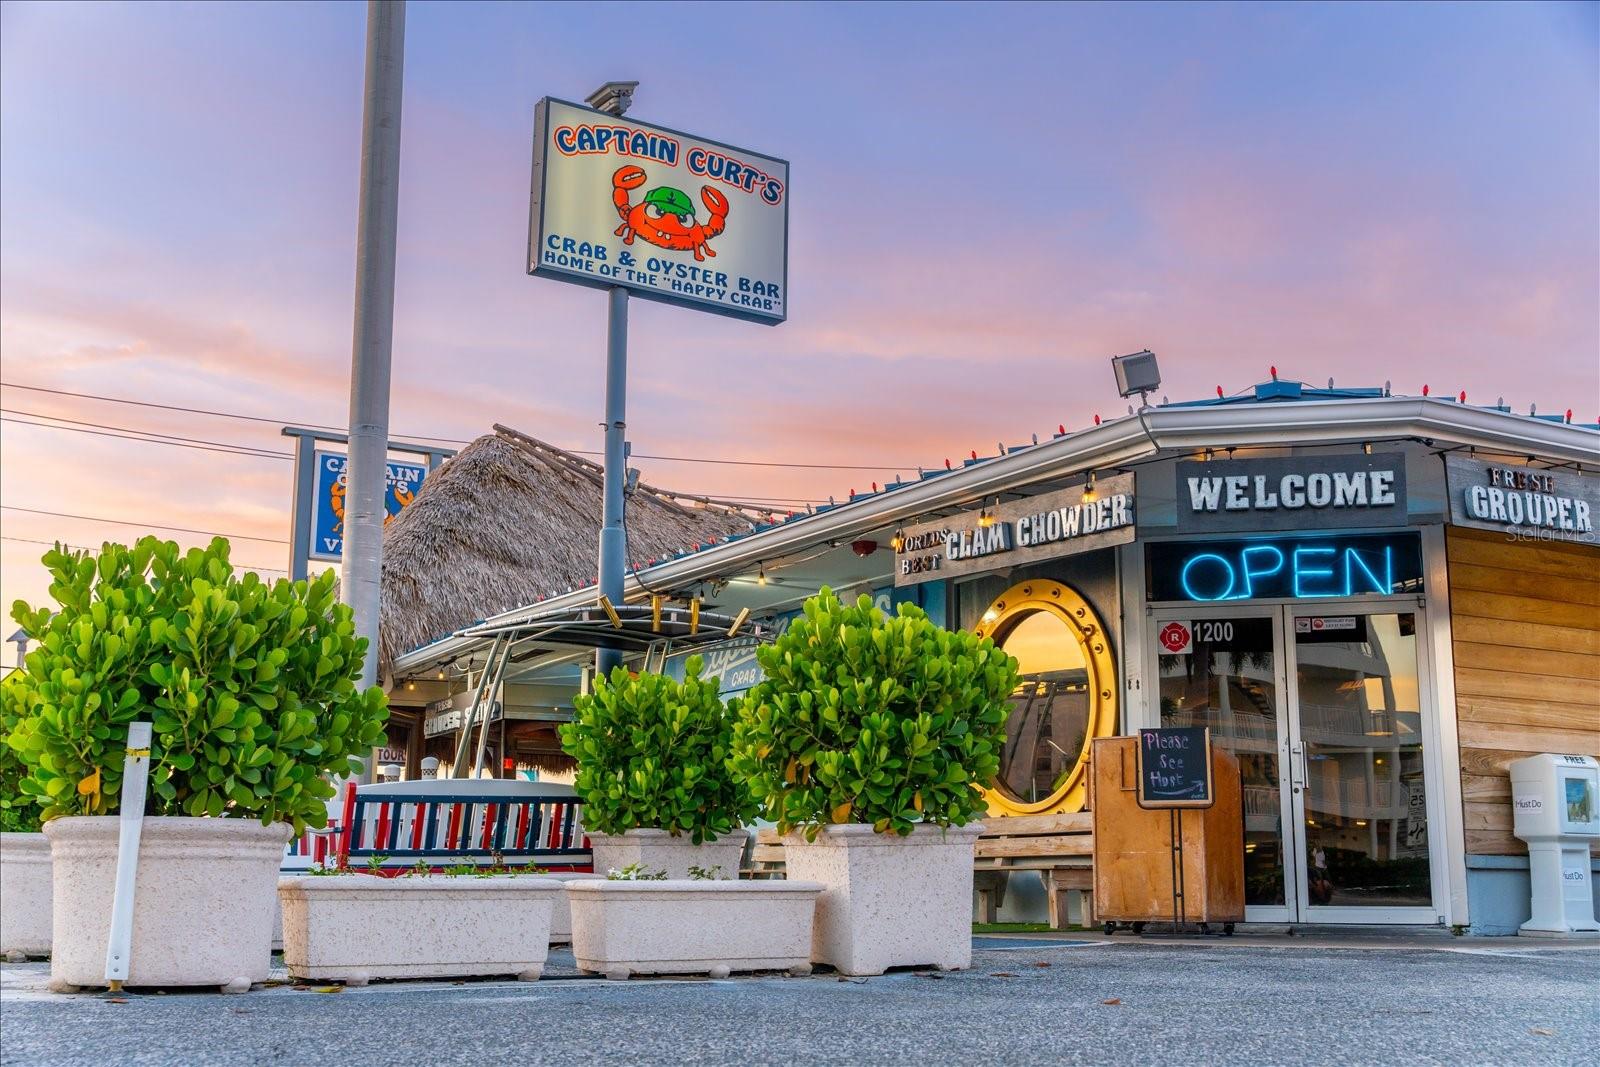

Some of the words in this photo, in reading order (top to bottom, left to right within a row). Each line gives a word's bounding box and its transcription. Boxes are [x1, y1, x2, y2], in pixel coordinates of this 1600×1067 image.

[556, 125, 678, 165] CAPTAIN
[688, 149, 783, 204] CURT'S
[547, 234, 607, 261] CRAB
[618, 251, 636, 267] &
[646, 257, 728, 288] OYSTER
[738, 276, 780, 299] BAR
[544, 250, 594, 272] HOME
[599, 263, 621, 278] OF
[626, 269, 658, 286] THE
[663, 277, 726, 300] "HAPPY
[731, 292, 781, 311] CRAB"
[1187, 470, 1396, 512] WELCOME
[1489, 467, 1555, 493] FRESH
[1468, 485, 1592, 532] GROUPER
[946, 522, 1006, 560] CLAM
[1015, 494, 1132, 547] CHOWDER
[901, 553, 940, 575] BEST
[1181, 545, 1393, 602] OPEN
[1171, 633, 1179, 641] R
[1194, 622, 1234, 642] 1200
[731, 671, 756, 686] CRAB
[1143, 732, 1189, 750] Please
[1160, 754, 1184, 769] See
[1564, 755, 1586, 765] FREE
[1150, 770, 1184, 788] Host
[1532, 800, 1542, 808] Do
